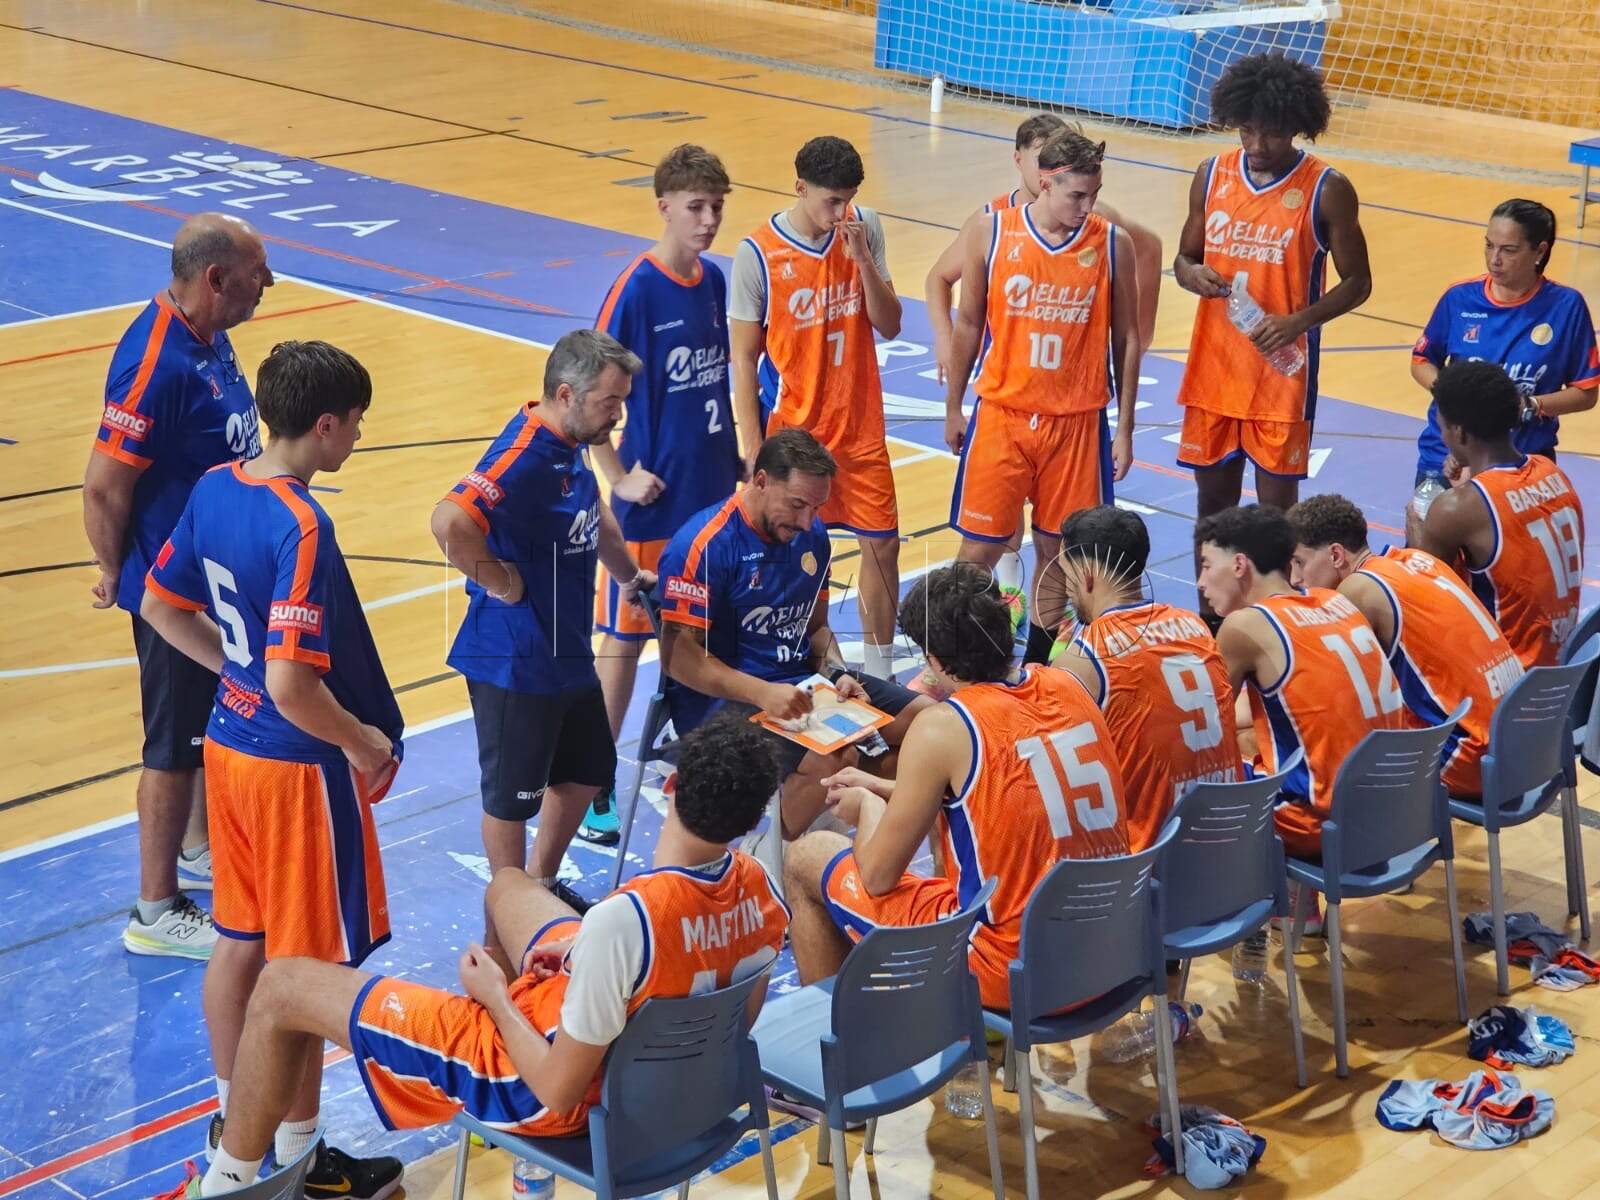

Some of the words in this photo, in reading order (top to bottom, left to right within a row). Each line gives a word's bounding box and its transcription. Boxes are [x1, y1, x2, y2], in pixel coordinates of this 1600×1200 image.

[1034, 305, 1090, 323] DEPORTE
[827, 331, 846, 366] 7
[1029, 332, 1063, 369] 10
[104, 406, 147, 433] suma
[705, 398, 723, 435] 2
[464, 471, 500, 501] suma
[1526, 506, 1583, 599] 18
[668, 579, 708, 600] suma
[203, 557, 254, 668] 5
[270, 605, 319, 625] suma
[1434, 576, 1500, 642] 1
[1320, 625, 1403, 719] 12
[1160, 653, 1224, 752] 9
[1016, 721, 1118, 840] 15
